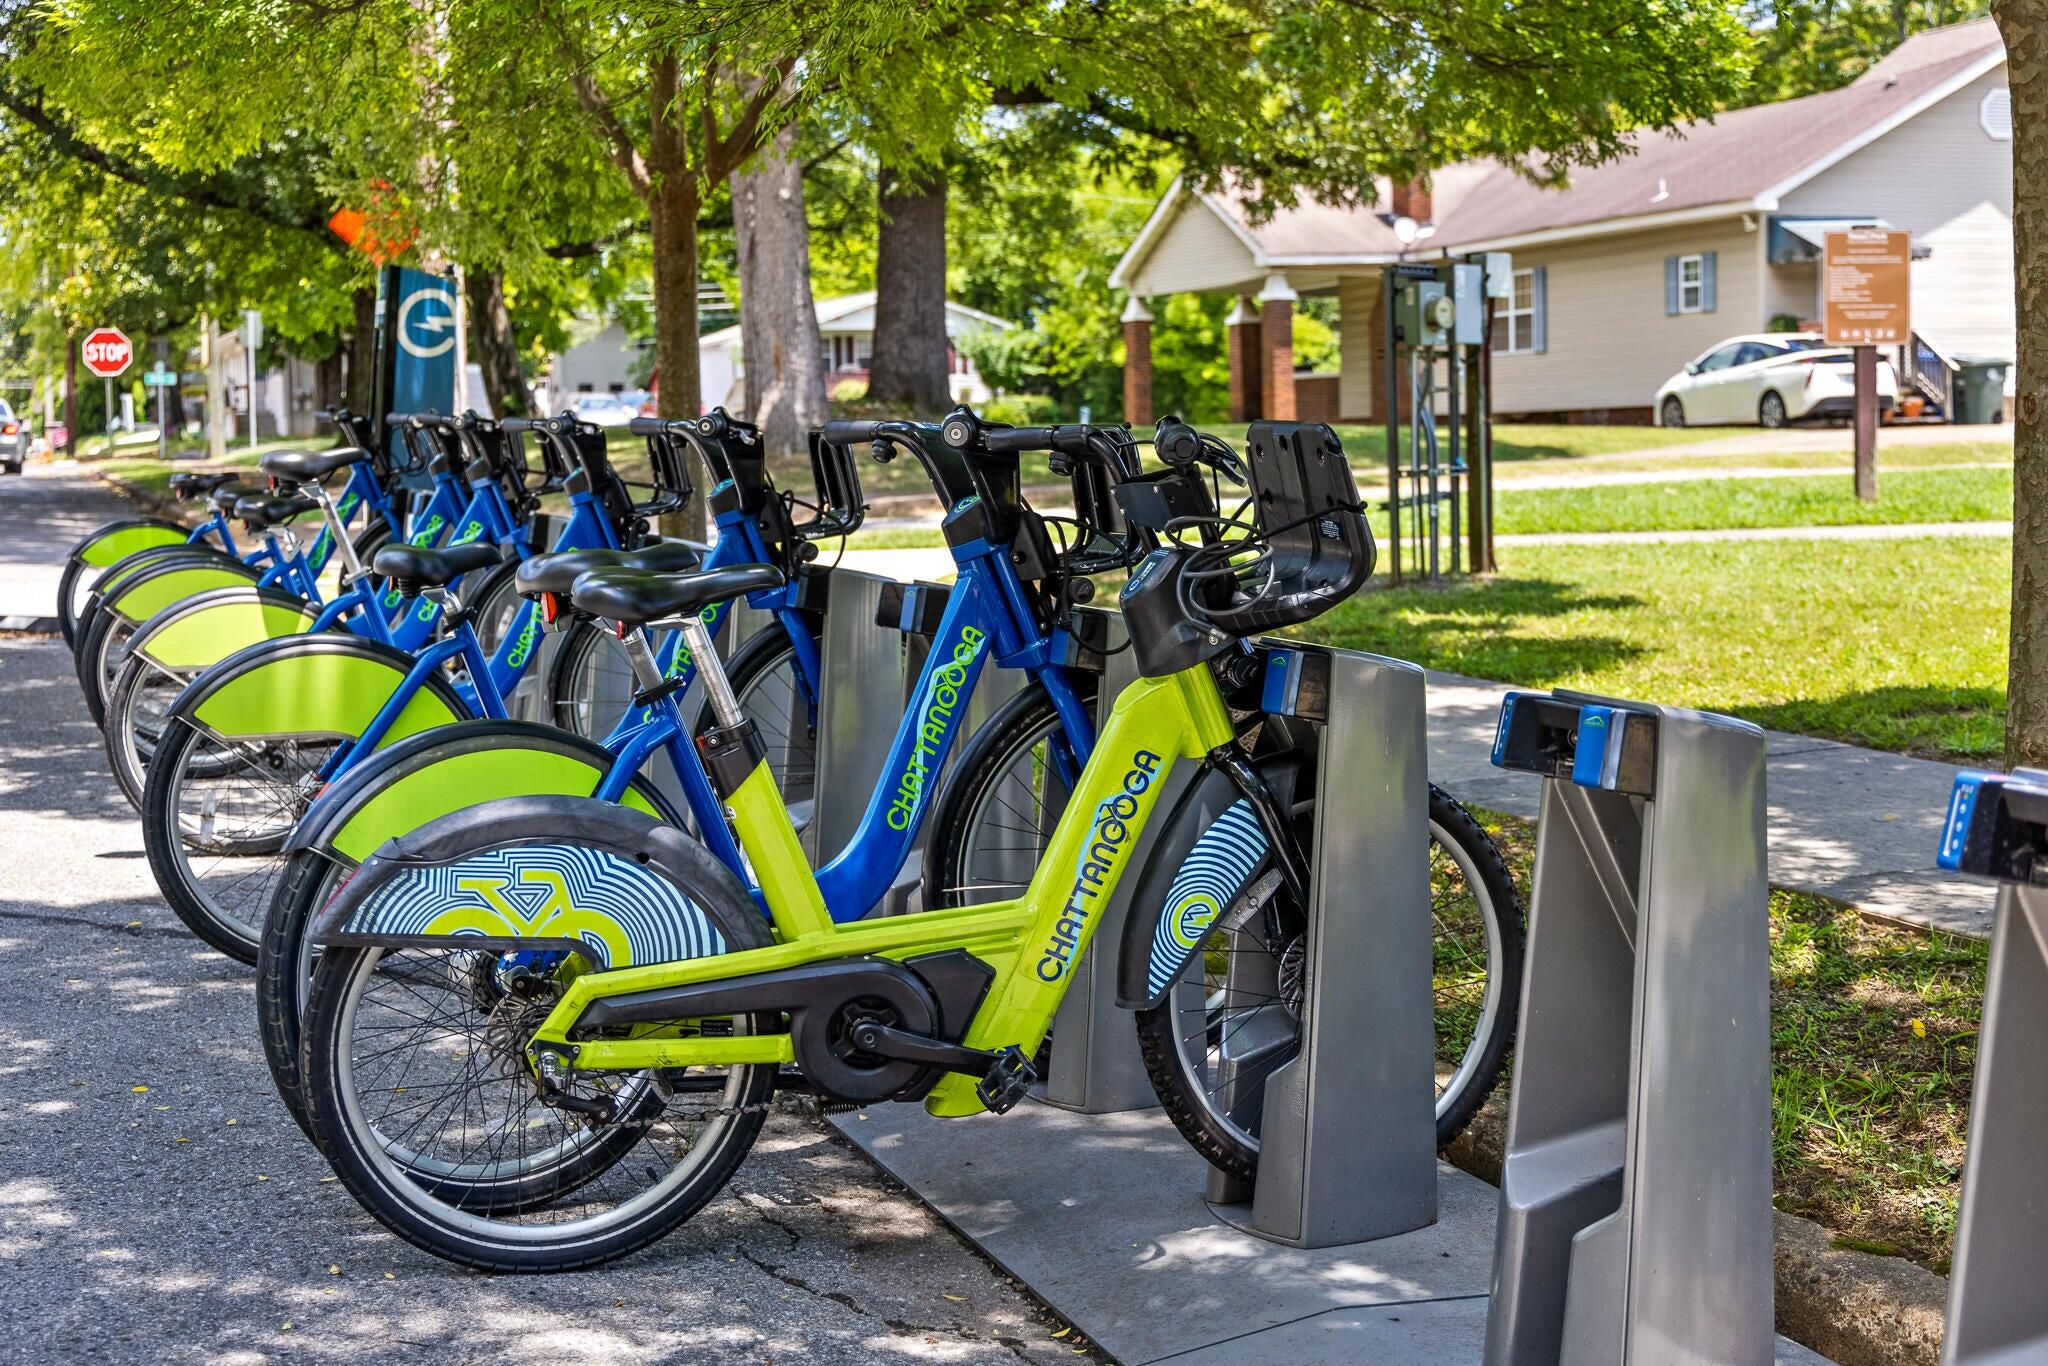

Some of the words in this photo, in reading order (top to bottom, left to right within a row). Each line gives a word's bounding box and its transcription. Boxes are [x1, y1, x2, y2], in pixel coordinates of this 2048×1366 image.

[87, 342, 129, 362] STOP
[886, 625, 984, 831] CHATTANOOGA
[1036, 750, 1162, 982] CHATTANOOGA
